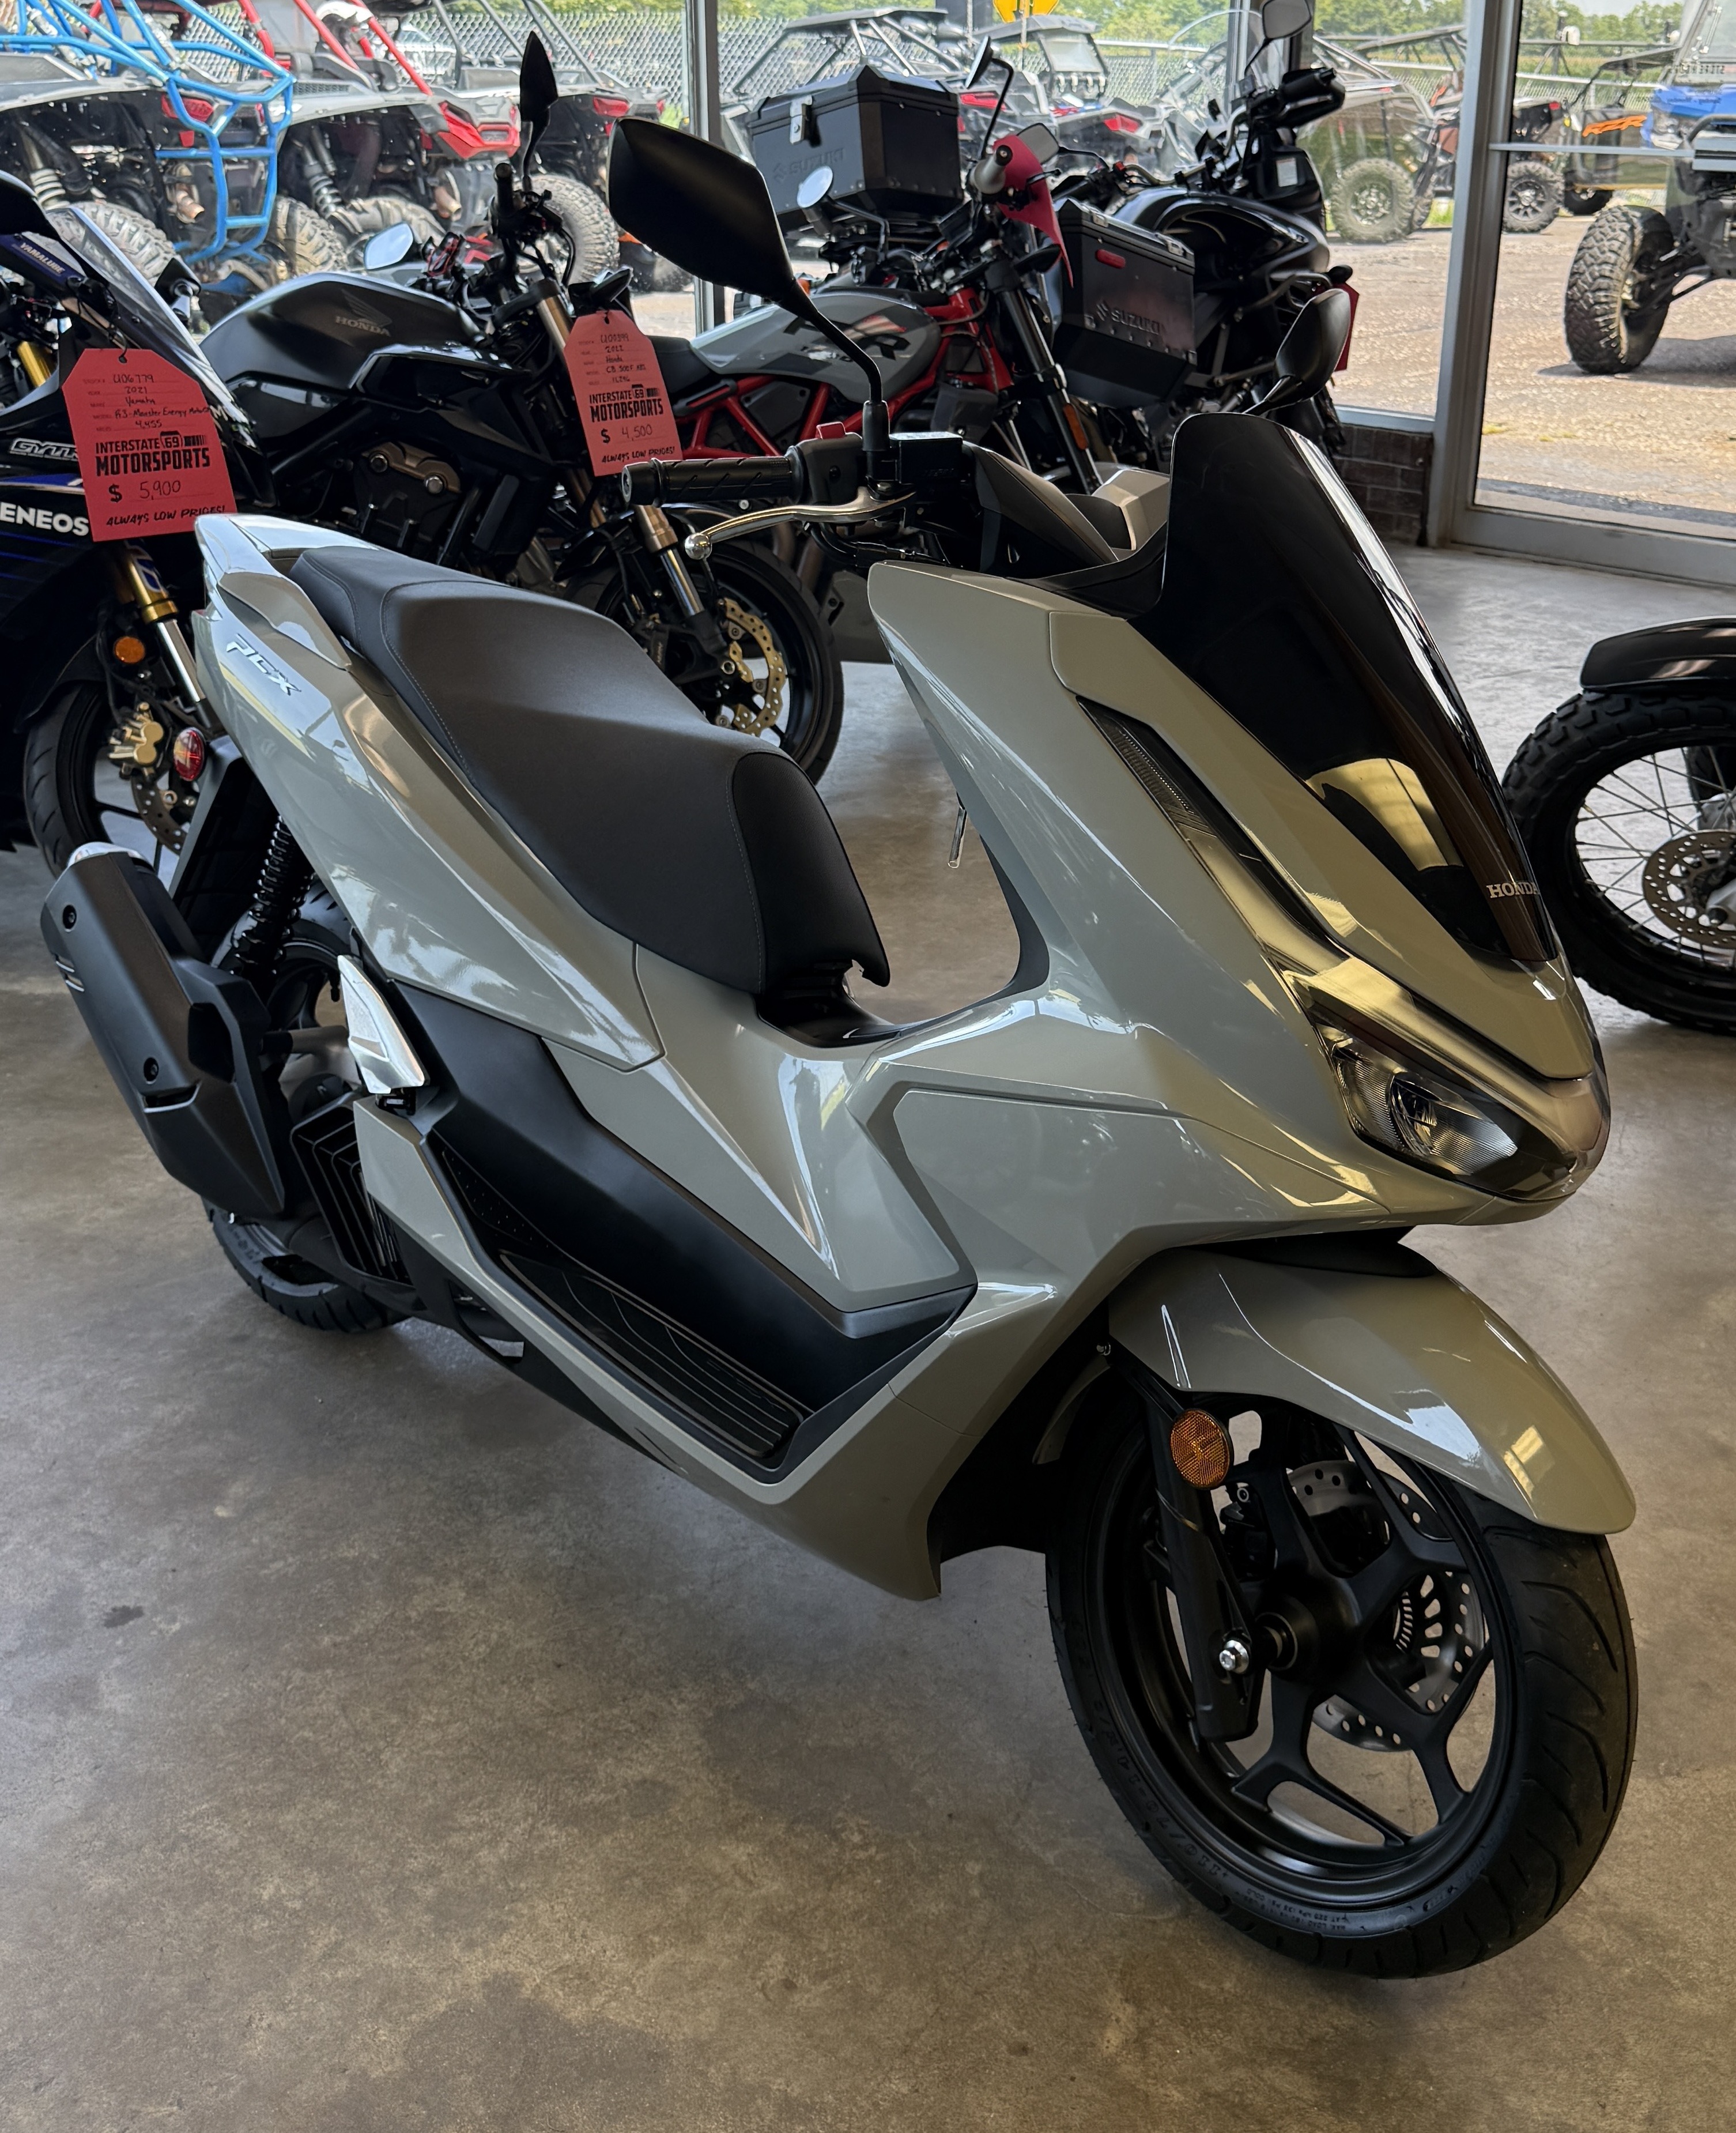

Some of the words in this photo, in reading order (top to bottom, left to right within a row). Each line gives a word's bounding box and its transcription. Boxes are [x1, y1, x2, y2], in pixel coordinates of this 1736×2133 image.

[789, 148, 844, 174] SUZUKI
[335, 316, 391, 337] HONDA
[1111, 307, 1160, 335] SUZUKI
[590, 390, 632, 404] INTERSTATE
[590, 399, 663, 423] MOTORSPORTS
[96, 438, 160, 454] INTERSTATE
[165, 436, 180, 449] 69
[601, 428, 611, 444] $
[622, 424, 652, 442] 4,500
[96, 447, 210, 477] MOTORSPORTS
[602, 453, 630, 463] ALWAYS
[632, 450, 646, 458] LOW
[108, 483, 123, 503] $
[140, 480, 181, 501] 5,900
[0, 502, 89, 536] ENEOS
[107, 512, 149, 526] ALWAYS
[154, 510, 177, 521] LOW
[226, 633, 302, 696] PCX
[1486, 881, 1540, 899] HONDA
